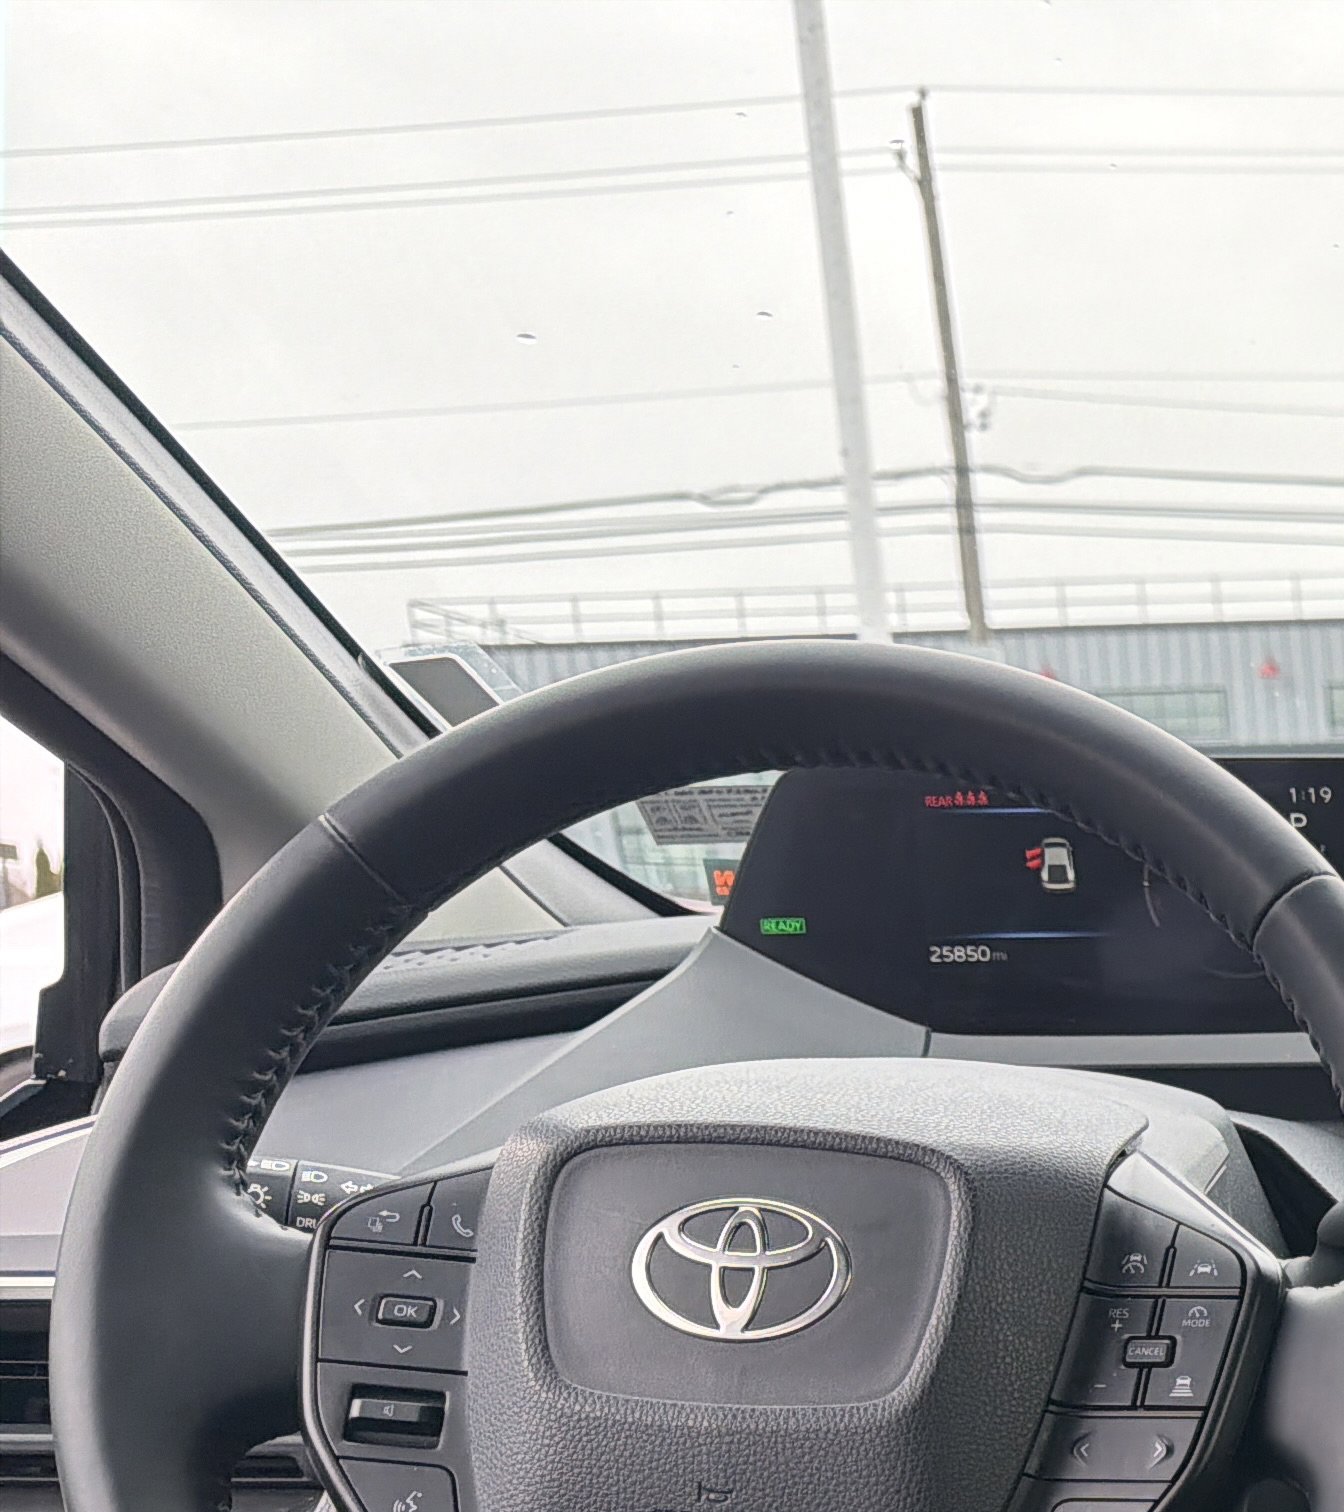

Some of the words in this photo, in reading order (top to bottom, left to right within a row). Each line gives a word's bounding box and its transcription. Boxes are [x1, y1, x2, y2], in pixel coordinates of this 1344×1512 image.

[924, 796, 953, 808] REAR
[1288, 786, 1333, 804] 1:19
[1289, 812, 1308, 829] P
[763, 919, 804, 933] READY
[929, 945, 991, 963] 25850
[393, 1303, 417, 1318] OK
[1108, 1307, 1130, 1319] RES
[1181, 1318, 1211, 1328] MODE
[1127, 1346, 1165, 1357] CANCEL
